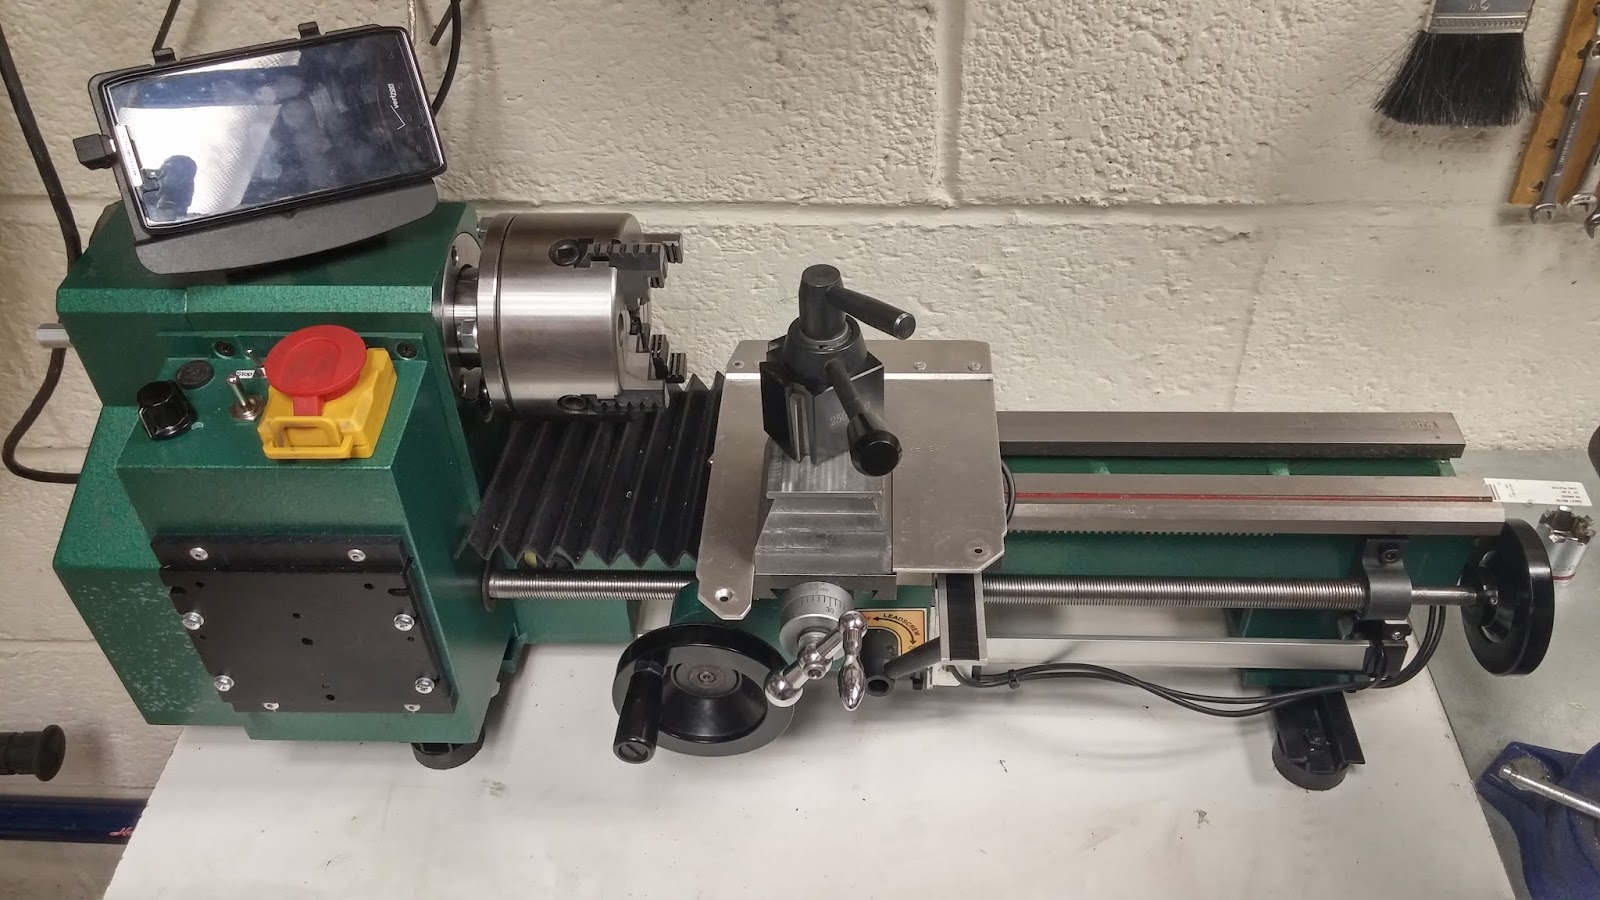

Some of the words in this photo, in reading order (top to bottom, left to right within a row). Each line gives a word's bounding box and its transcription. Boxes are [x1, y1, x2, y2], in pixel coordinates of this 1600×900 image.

[388, 83, 399, 109] verizon
[826, 606, 835, 614] 30
[883, 613, 920, 636] LEADSCREW
